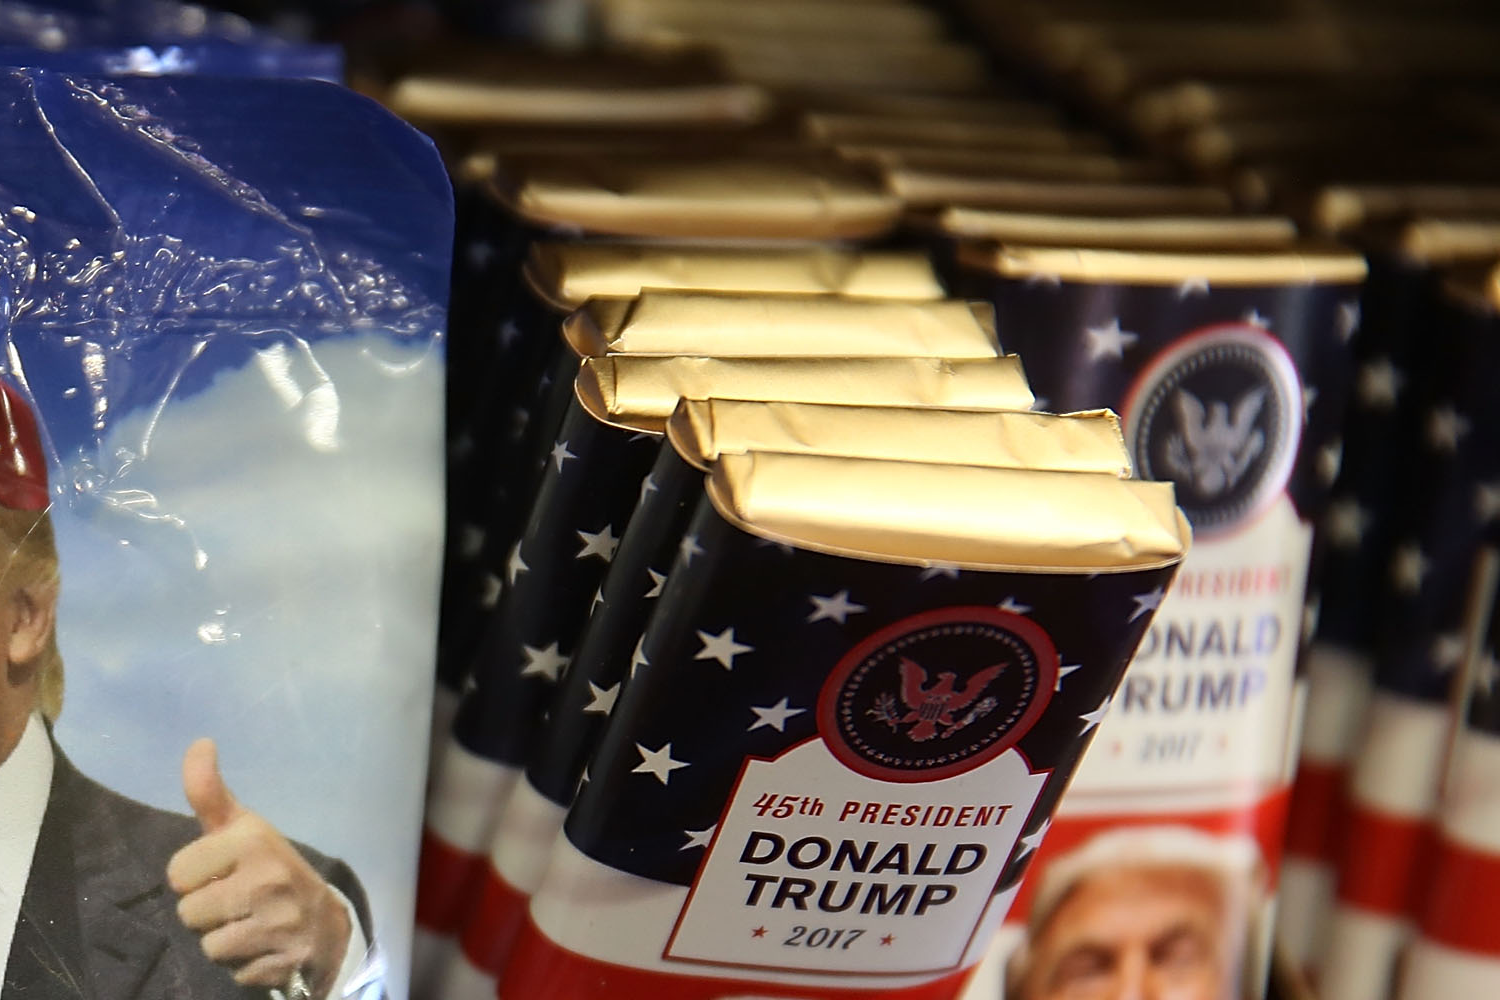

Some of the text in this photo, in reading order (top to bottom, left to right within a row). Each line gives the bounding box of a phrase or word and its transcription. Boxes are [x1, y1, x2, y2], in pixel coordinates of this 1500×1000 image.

[753, 793, 1012, 827] 45th PRESIDENT
[739, 831, 988, 876] DONALD
[745, 873, 958, 916] TRUMP
[783, 926, 867, 950] 2017
